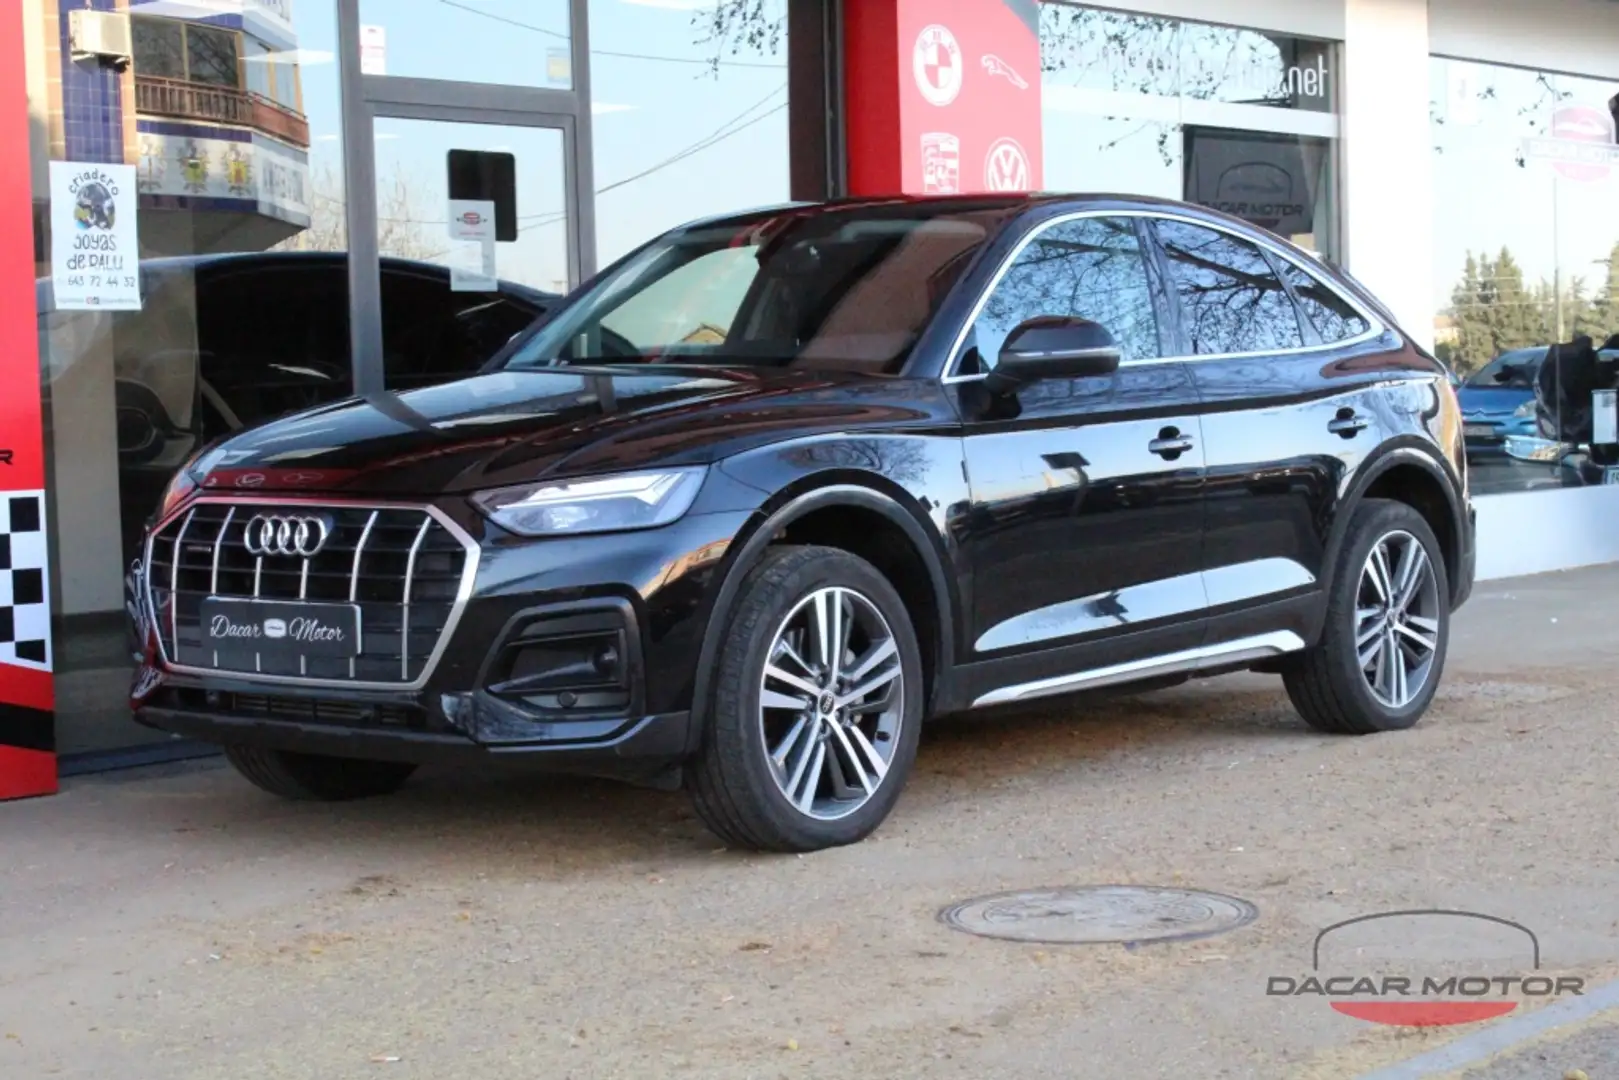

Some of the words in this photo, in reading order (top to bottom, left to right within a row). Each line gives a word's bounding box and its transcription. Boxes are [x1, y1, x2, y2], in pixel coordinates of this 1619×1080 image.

[68, 168, 120, 196] criadero
[1250, 203, 1305, 217] MOTOR
[209, 614, 262, 639] Dacar
[288, 616, 345, 642] Motor
